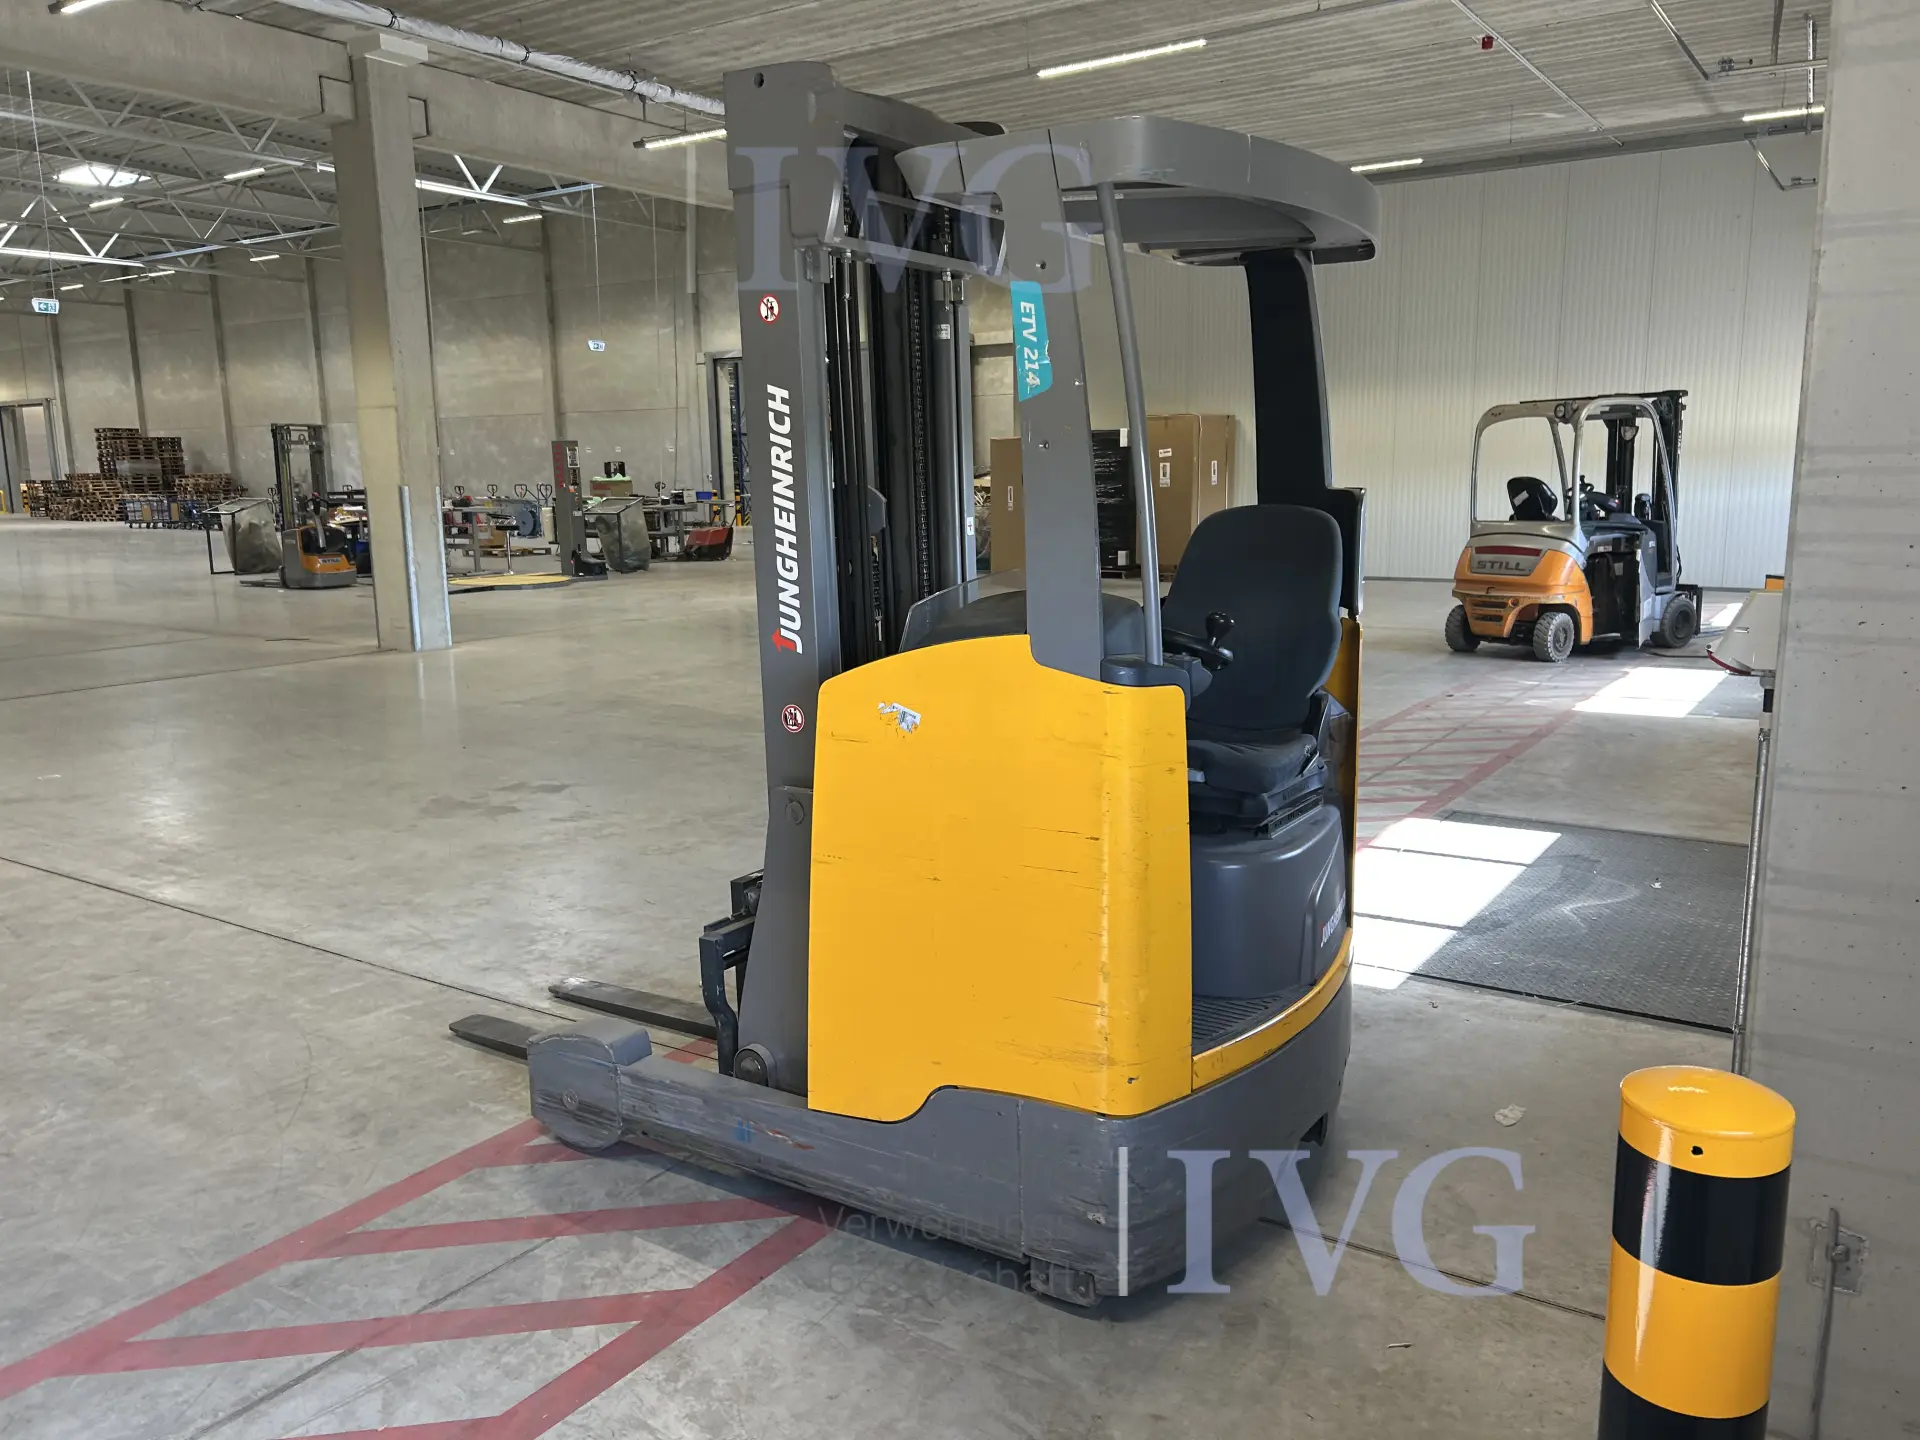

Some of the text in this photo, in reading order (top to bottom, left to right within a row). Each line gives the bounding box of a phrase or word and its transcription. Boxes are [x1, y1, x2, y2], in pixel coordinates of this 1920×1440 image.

[1020, 301, 1041, 389] ETV 214
[767, 383, 804, 655] JUNGHEINRICH
[1476, 560, 1526, 571] STILL
